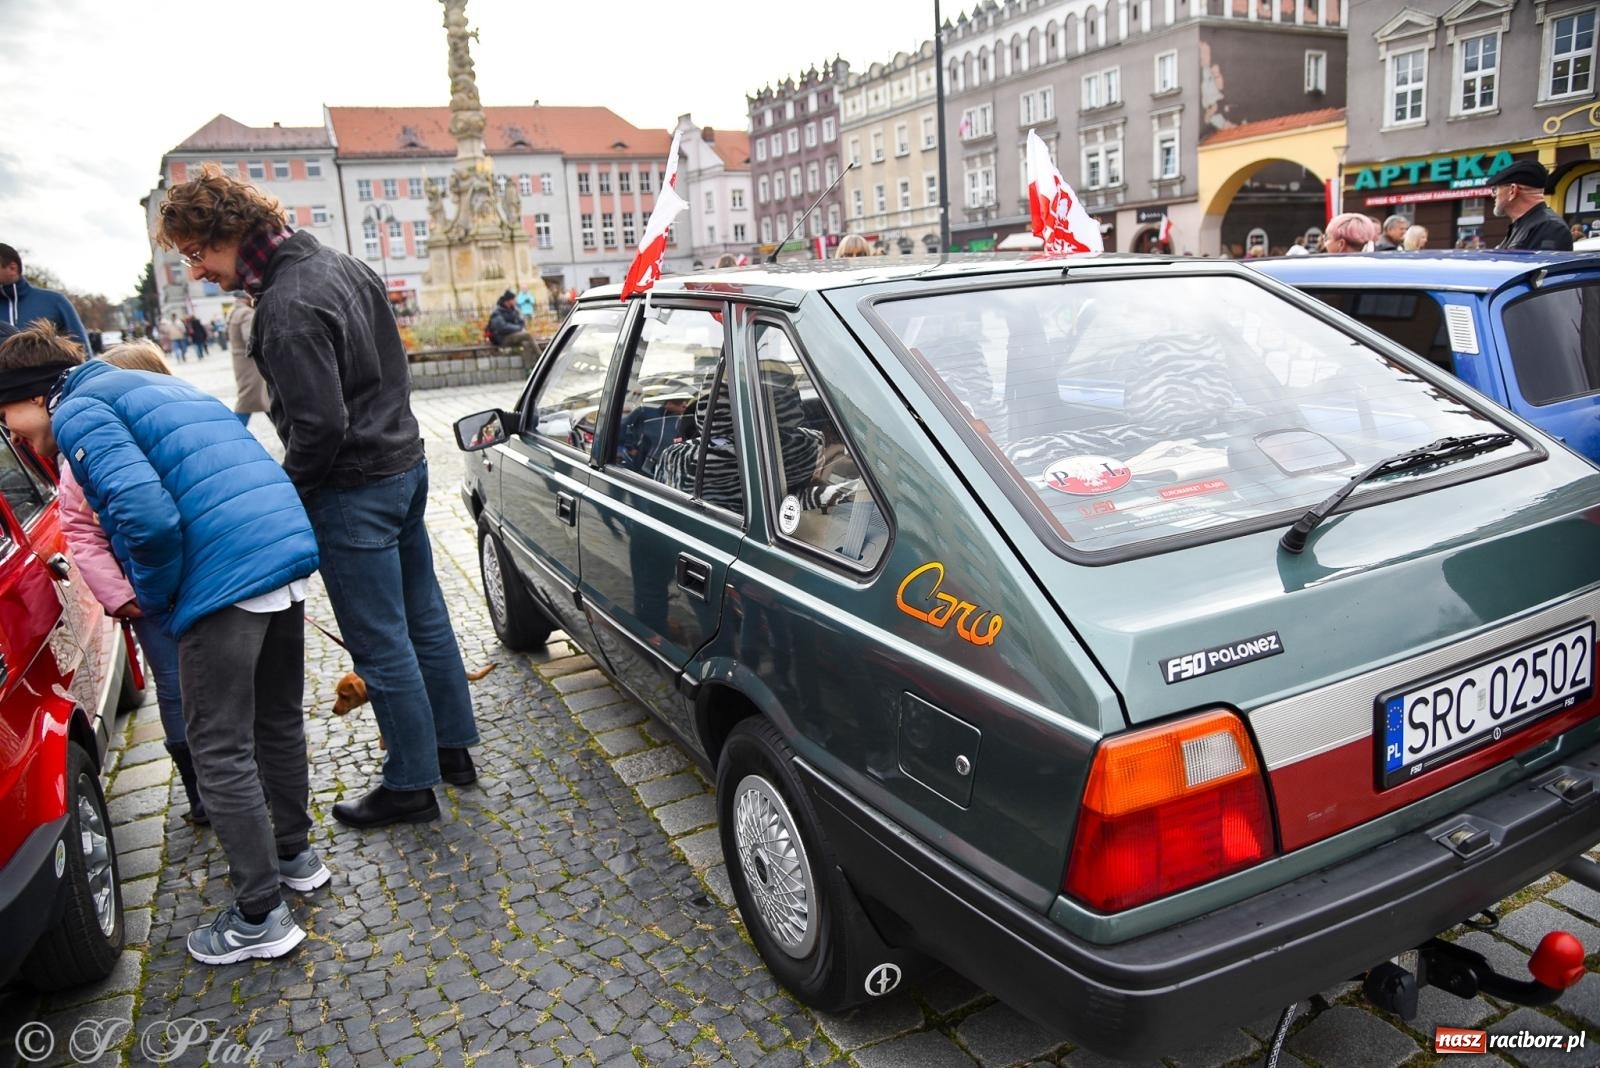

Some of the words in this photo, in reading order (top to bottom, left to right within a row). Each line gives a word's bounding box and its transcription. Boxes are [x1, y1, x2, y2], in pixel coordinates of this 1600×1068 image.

[1354, 150, 1514, 190] APTEKA
[1167, 651, 1206, 682] FSO
[1408, 678, 1477, 755] SRC
[1489, 635, 1588, 721] 02502
[1386, 742, 1401, 762] PL
